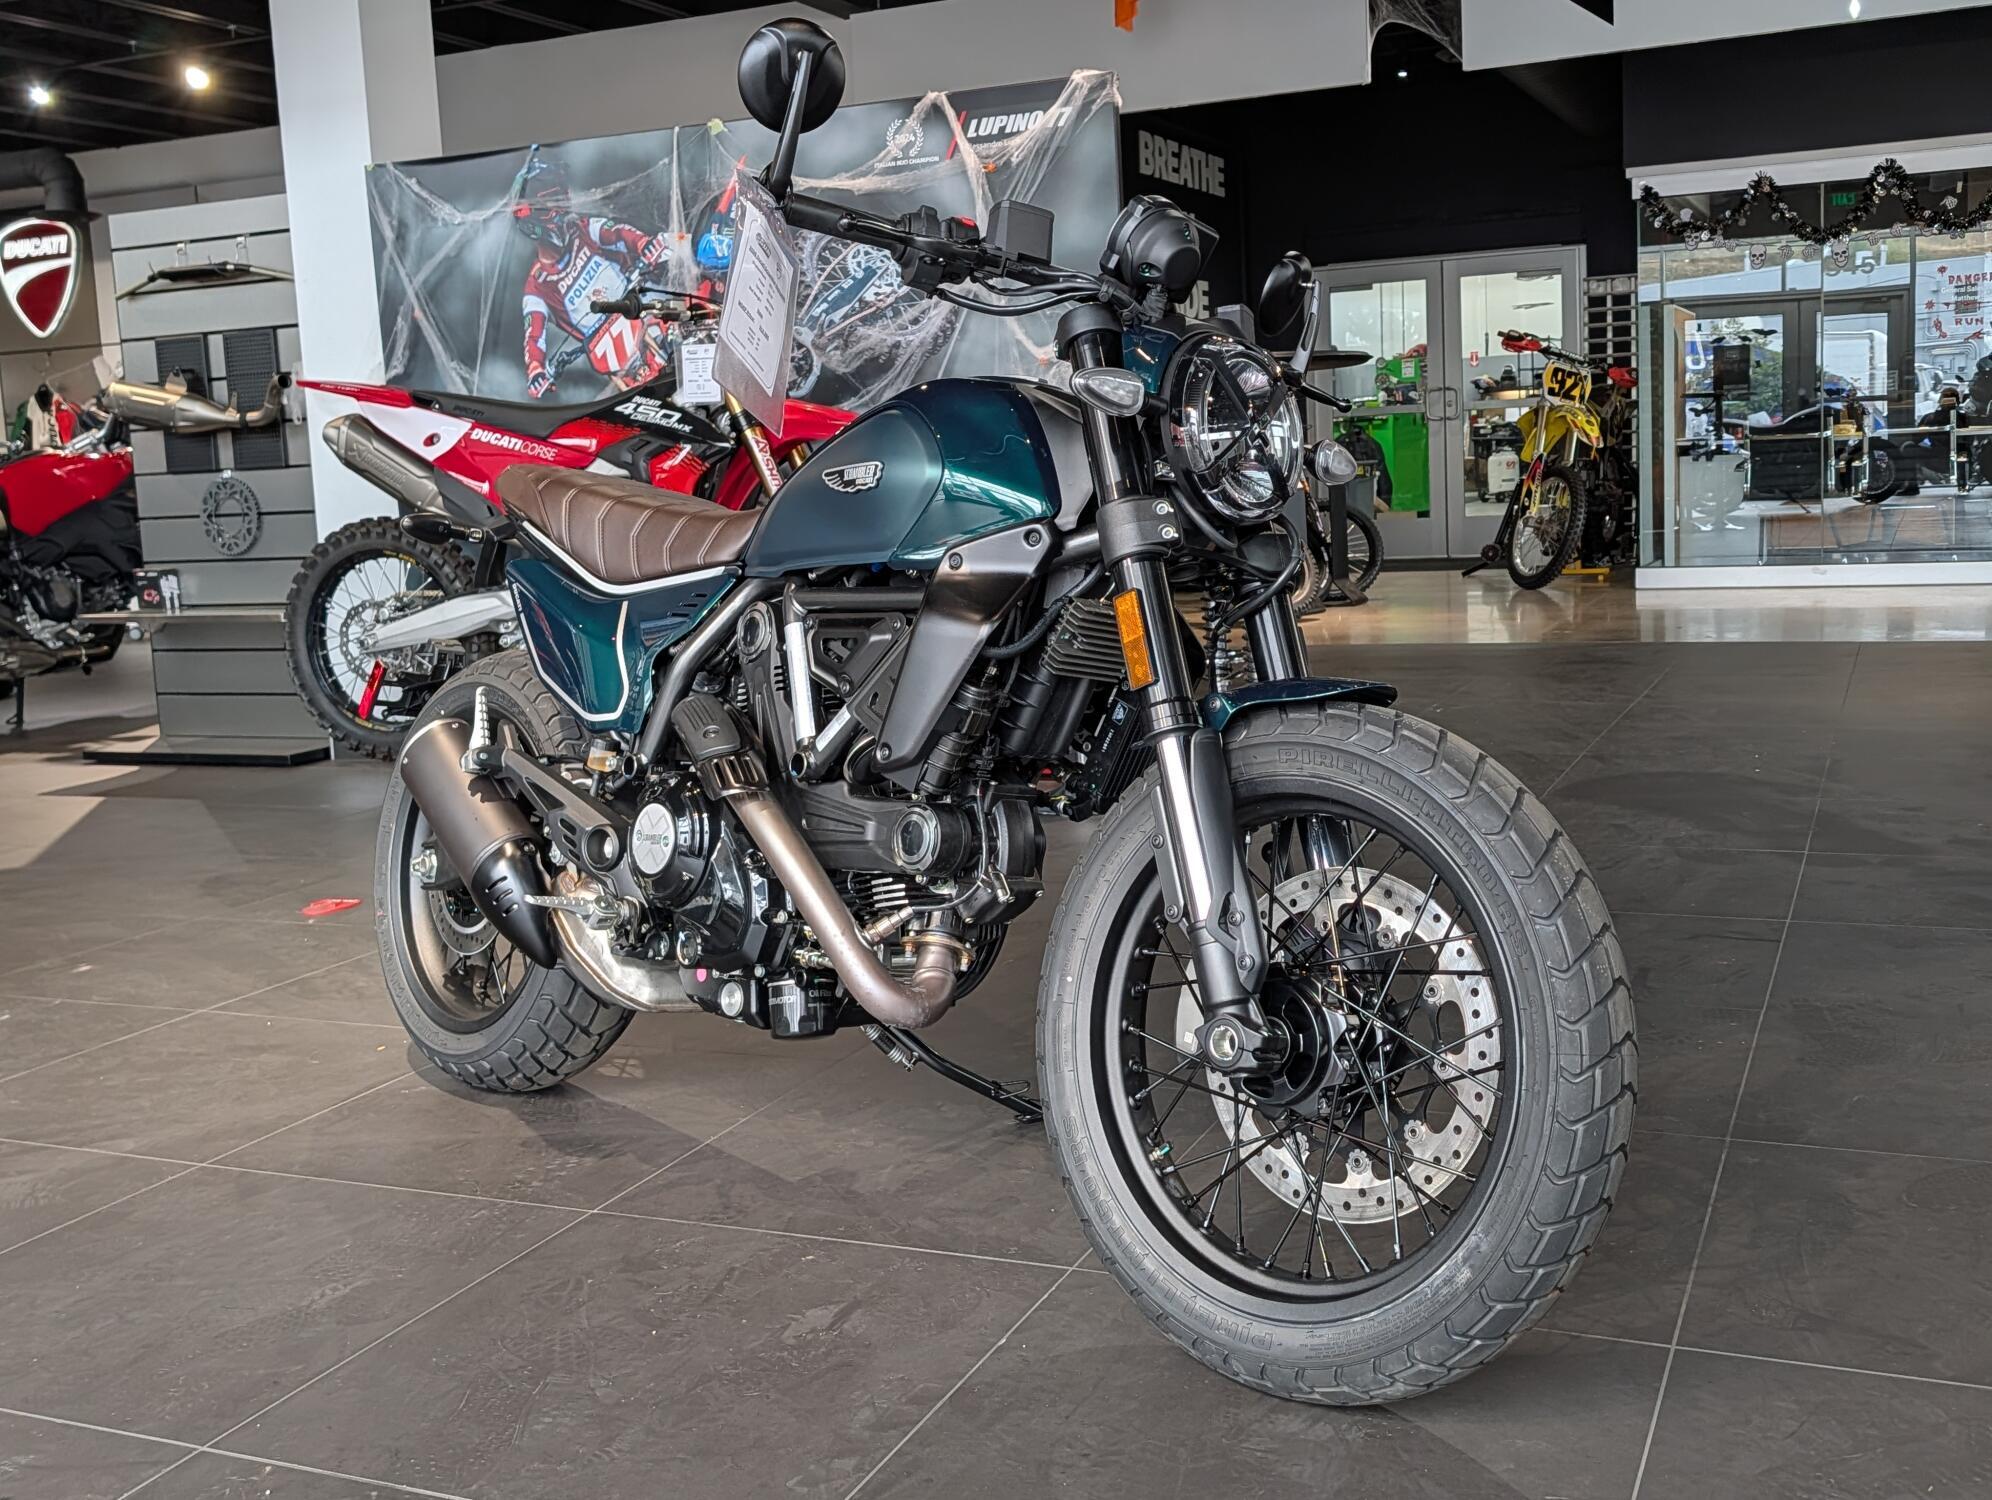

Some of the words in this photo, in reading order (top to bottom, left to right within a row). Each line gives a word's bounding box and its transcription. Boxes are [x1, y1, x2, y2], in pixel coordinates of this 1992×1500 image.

[967, 113, 1040, 138] LUPINO
[909, 156, 940, 165] CHAMPION
[1138, 130, 1226, 198] BREATHE
[3, 234, 68, 260] DUCATI
[557, 246, 592, 294] DUCATI
[568, 260, 603, 306] POLIZIA
[1955, 317, 1984, 326] RUN
[614, 402, 682, 424] 450
[632, 395, 662, 407] DUCATI
[512, 582, 523, 612] DUCATI
[1278, 748, 1415, 801] PIRELLI
[1147, 1267, 1276, 1350] PIRELLI
